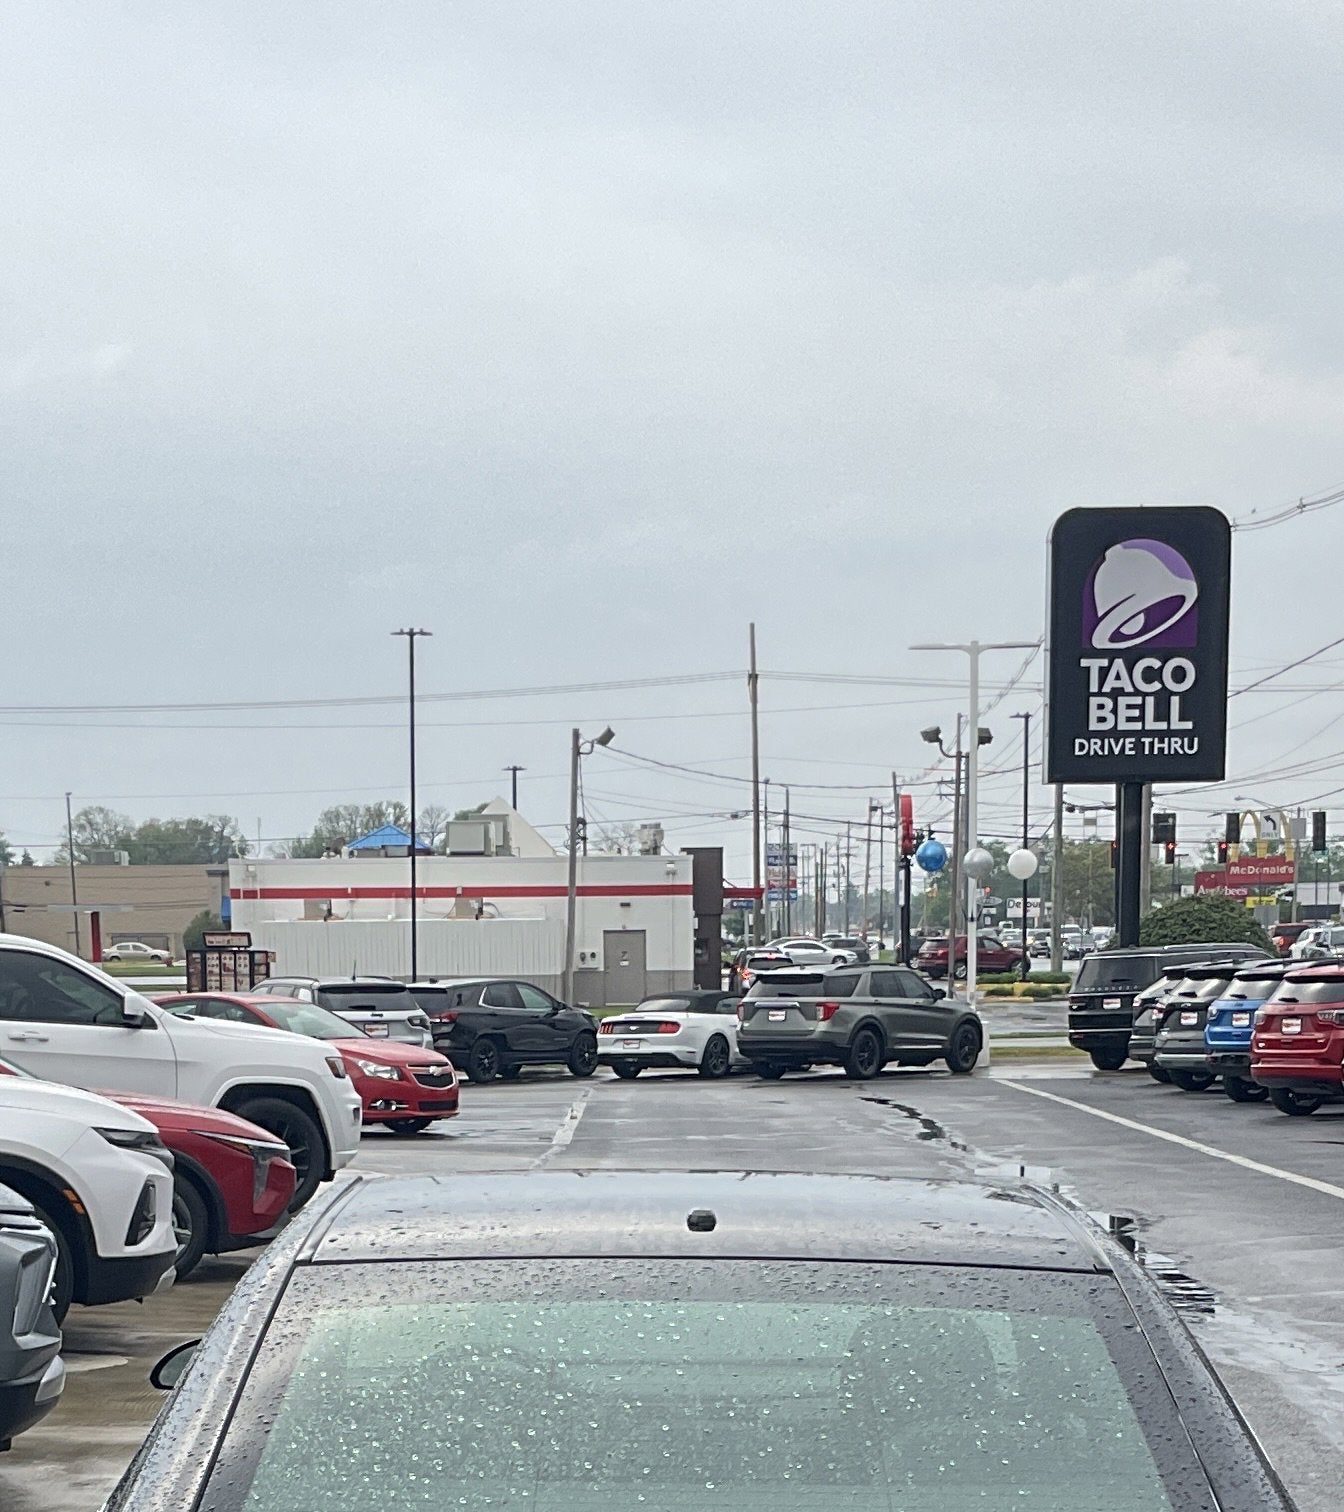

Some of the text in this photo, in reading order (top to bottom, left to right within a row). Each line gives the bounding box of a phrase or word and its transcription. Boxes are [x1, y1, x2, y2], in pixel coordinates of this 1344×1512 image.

[1080, 657, 1196, 692] TACO
[1088, 695, 1193, 731] BELL
[1074, 737, 1199, 756] DRIVE THRU
[1229, 864, 1294, 875] McDonald's
